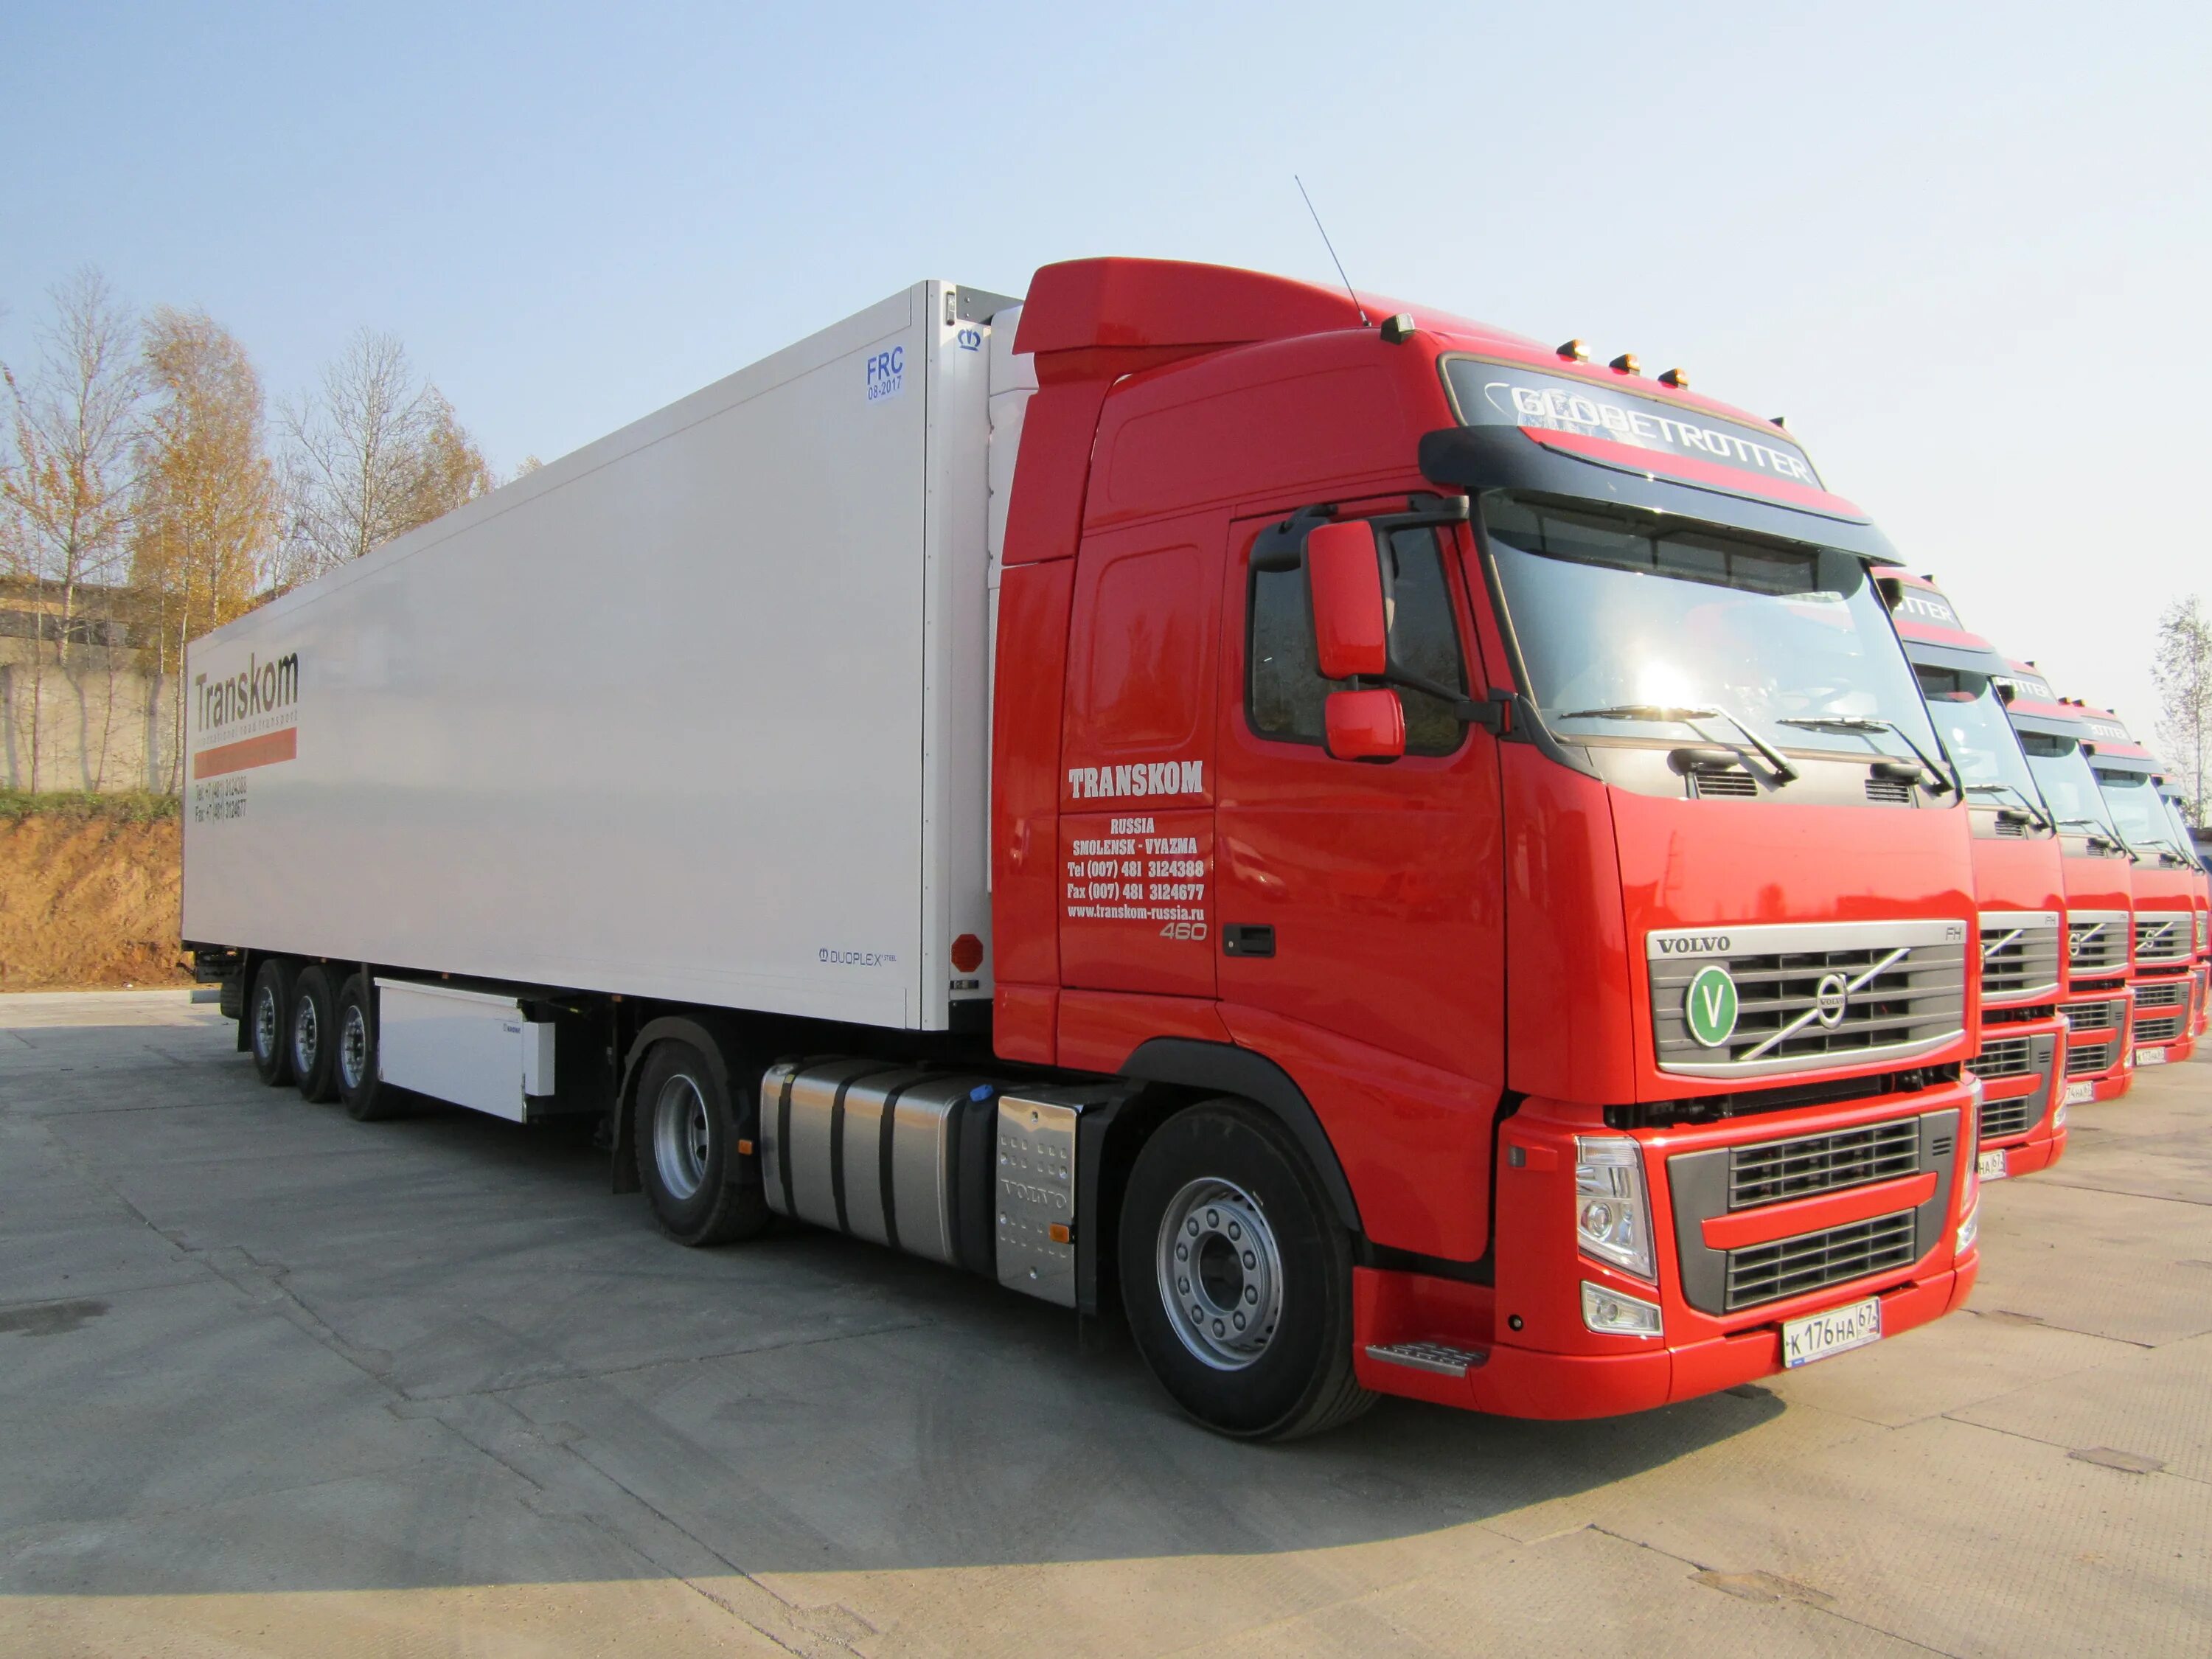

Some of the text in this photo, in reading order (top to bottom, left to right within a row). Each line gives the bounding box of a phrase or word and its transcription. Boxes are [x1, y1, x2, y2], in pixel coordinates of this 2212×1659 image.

[867, 346, 903, 385] FRC
[868, 375, 902, 400] 08-2017
[1510, 386, 1812, 484] GLOBETROTTER
[195, 652, 299, 732] Transkom
[1068, 760, 1203, 799] TRANSKOM
[1110, 817, 1155, 835] RUSSIA
[1073, 838, 1135, 856] SMOLENSK
[1145, 837, 1197, 855] VYAZMA
[1067, 860, 1204, 879] Tel (007) 481 3124388
[1067, 882, 1204, 901] Fax (007) 481 3124677
[1067, 903, 1204, 921] www.transkom-russia.ru
[1159, 922, 1208, 941] 460
[1945, 926, 1962, 941] FH
[1657, 936, 1731, 954] VOLVO
[830, 950, 882, 967] DUOPLEX
[1702, 984, 1724, 1029] V
[1858, 1304, 1872, 1326] 67
